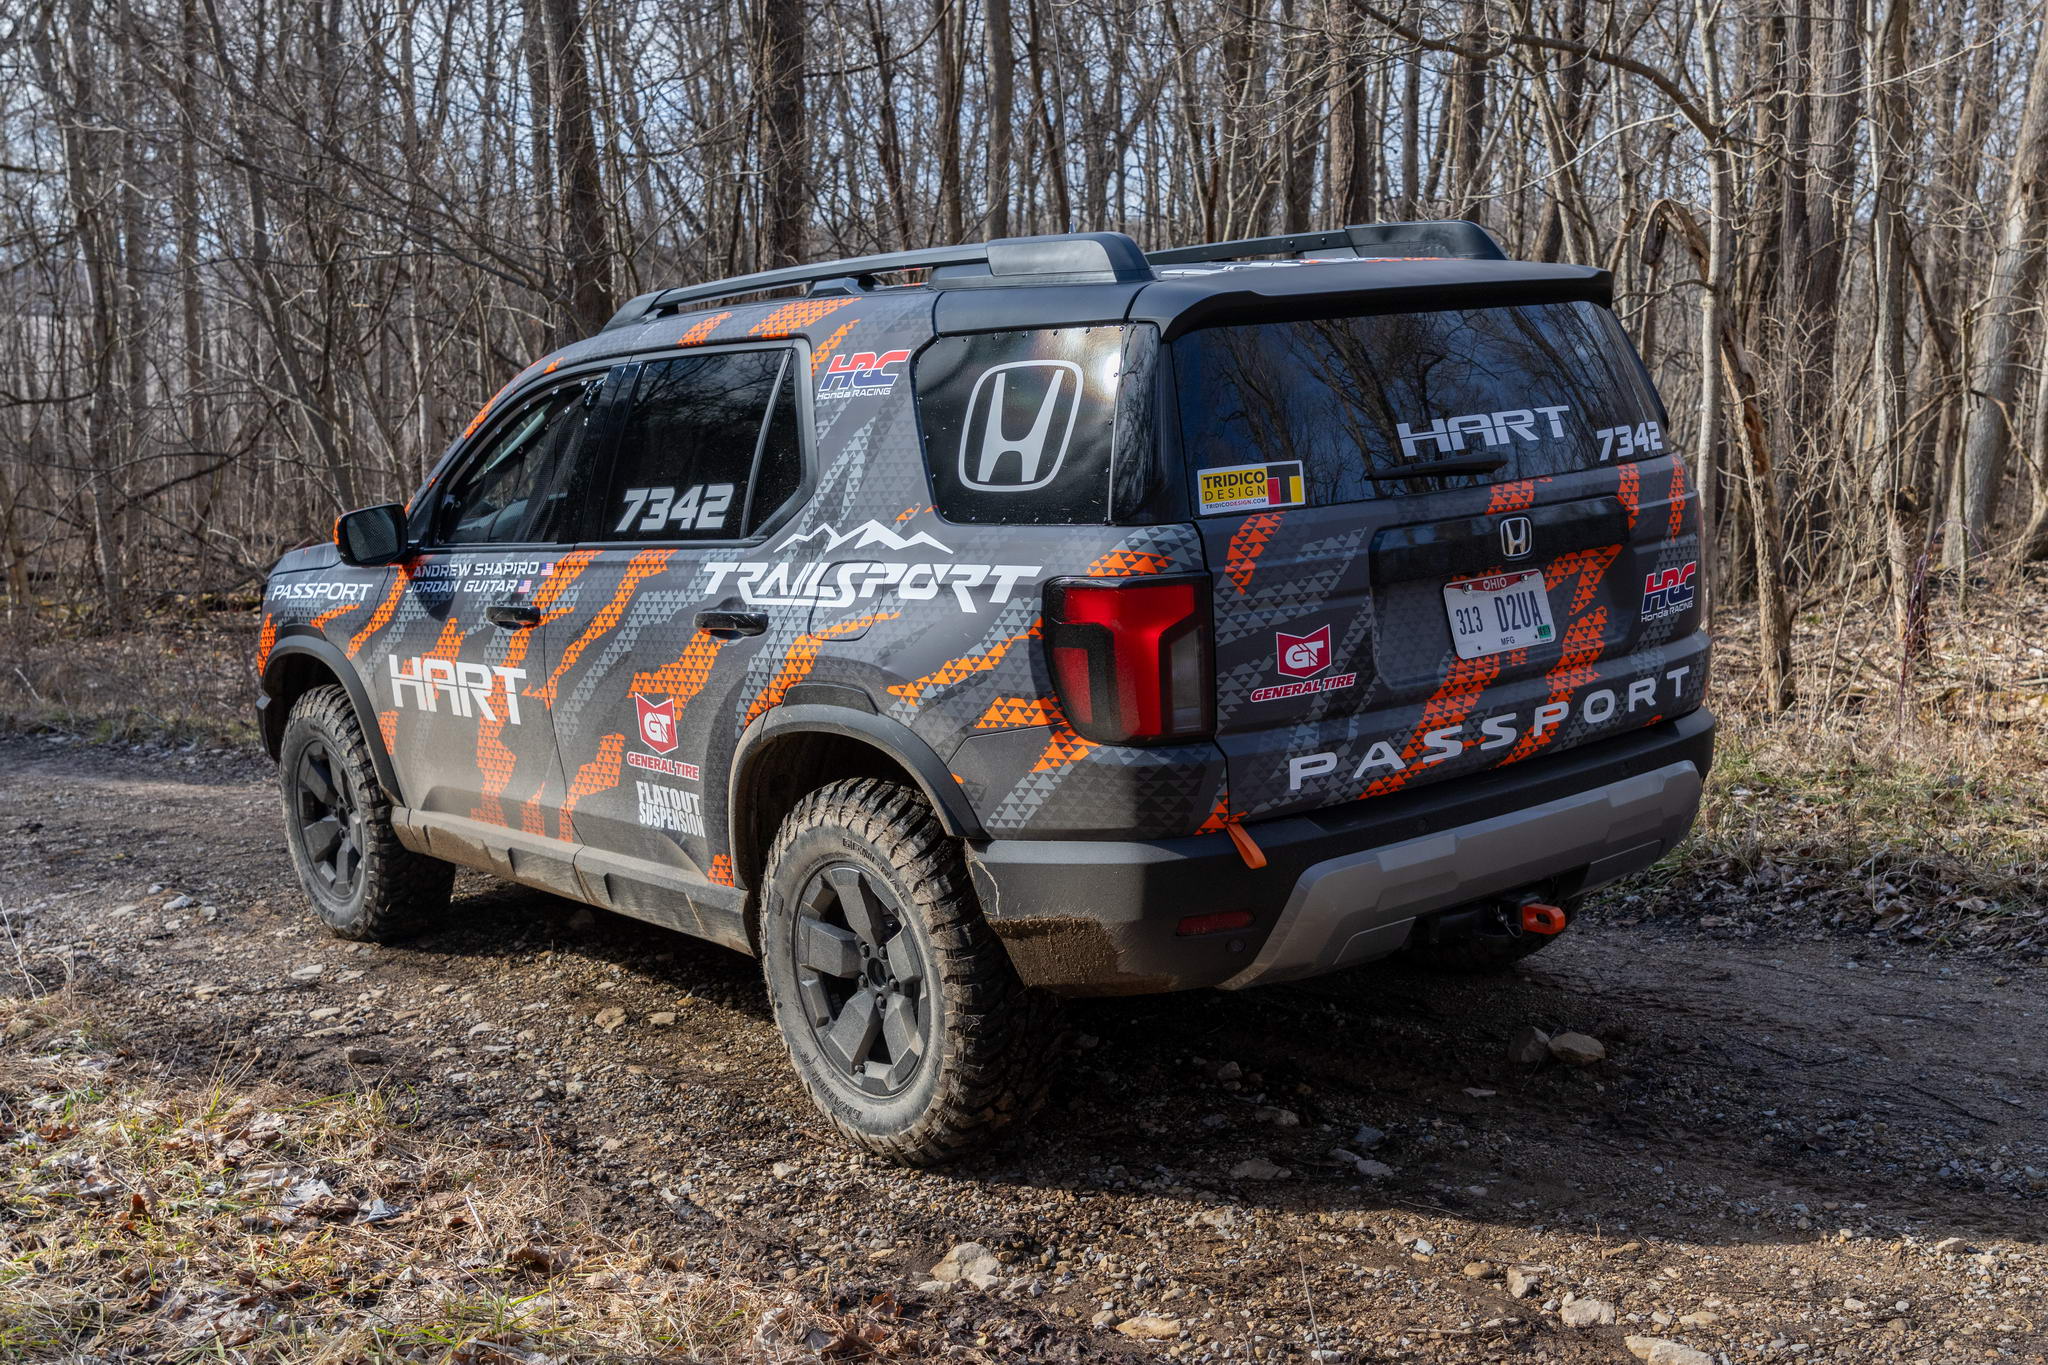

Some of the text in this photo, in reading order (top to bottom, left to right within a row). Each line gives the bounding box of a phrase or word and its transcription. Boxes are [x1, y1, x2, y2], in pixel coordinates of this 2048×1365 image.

[852, 387, 892, 398] RACING
[1396, 405, 1570, 457] HART
[1596, 421, 1664, 461] 7342
[1203, 471, 1266, 489] TRIDICO
[1204, 485, 1266, 501] DESIGN
[614, 484, 735, 533] 7342
[1205, 498, 1267, 510] TRIDICODESIGN.COM
[412, 561, 540, 577] ANDREW SHAPIRO
[1482, 577, 1507, 591] OHIO
[271, 582, 374, 602] PASSPORT
[405, 579, 519, 593] JORDAN GUITAR
[703, 561, 1042, 614] TRAILSPORT
[1455, 590, 1544, 636] 313 D2UA
[1669, 600, 1693, 615] RACING
[1500, 636, 1516, 646] MFG
[388, 654, 527, 726] HART
[1251, 672, 1356, 702] GENERAL TIRE
[1288, 665, 1692, 791] PASSPORT
[627, 751, 700, 781] GENERAL TIRE
[635, 780, 700, 816] FLATOUT
[638, 801, 706, 838] SUSPENSION
